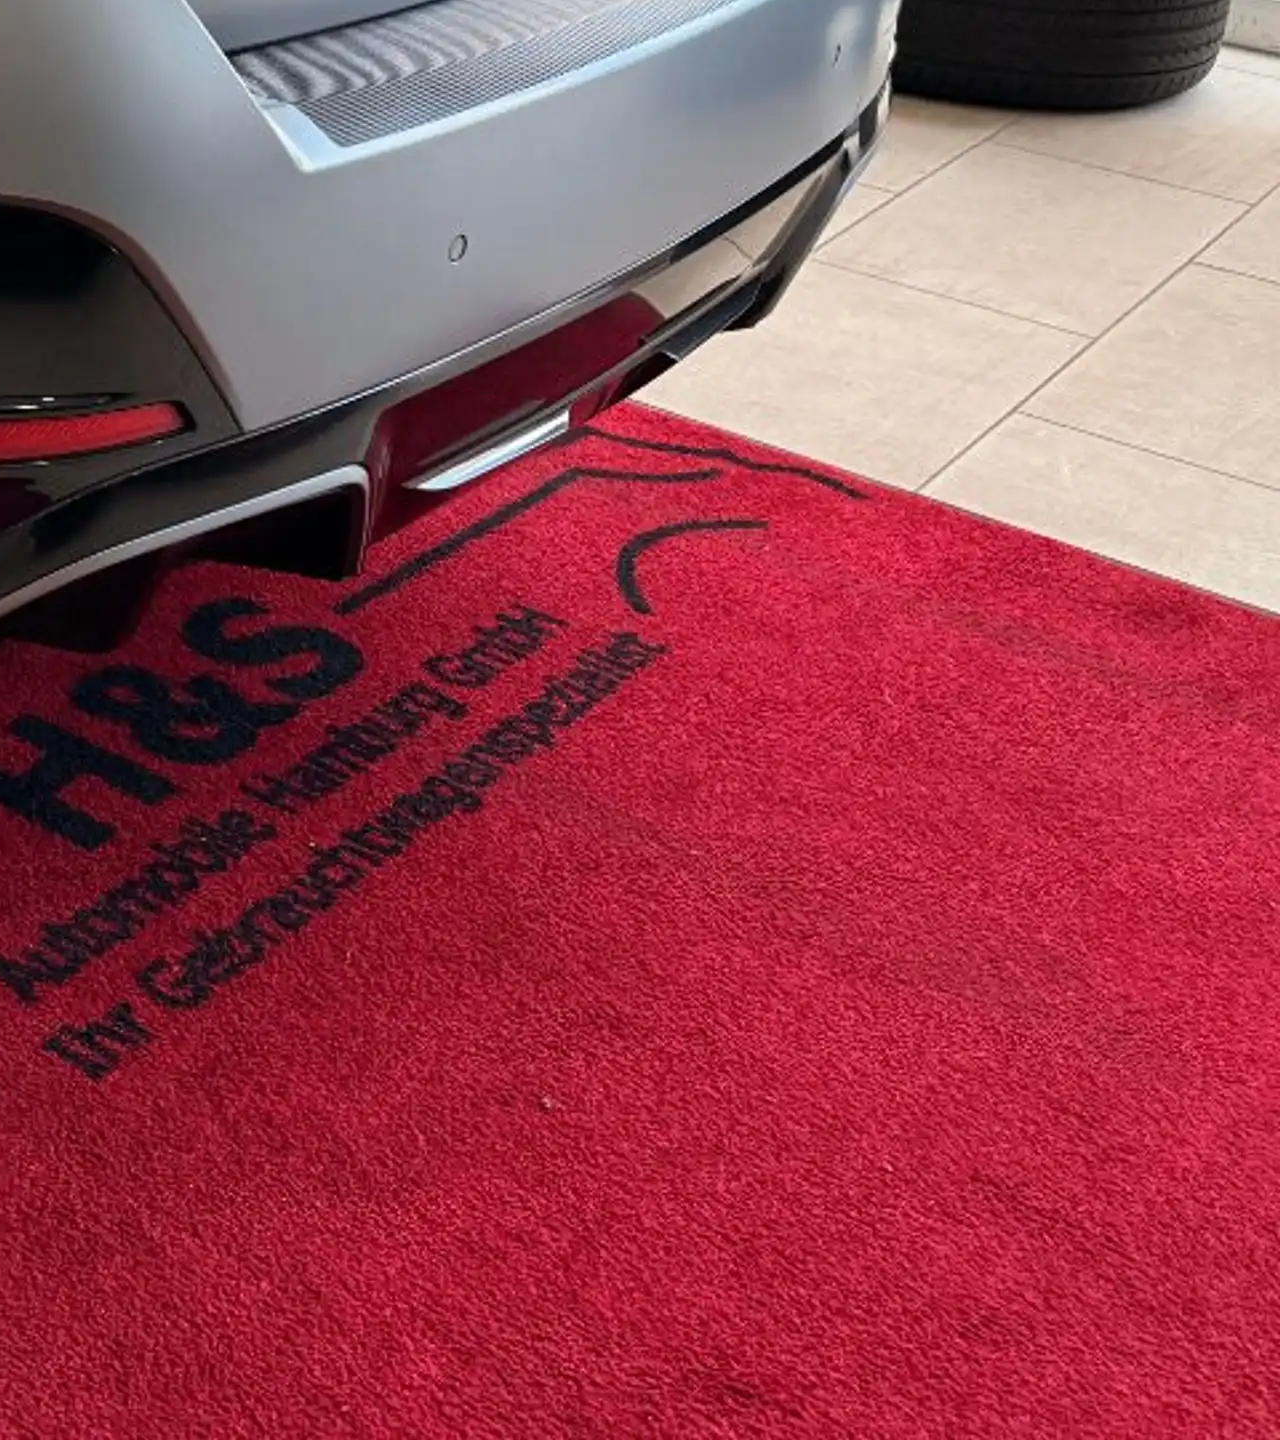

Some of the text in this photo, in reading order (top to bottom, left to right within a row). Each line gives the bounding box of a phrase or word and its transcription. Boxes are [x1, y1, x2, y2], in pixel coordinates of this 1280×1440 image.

[43, 631, 667, 1082] Ihr Gebrauchtwagenspezialist
[241, 681, 468, 815] Hamburg
[420, 602, 570, 689] GmbH
